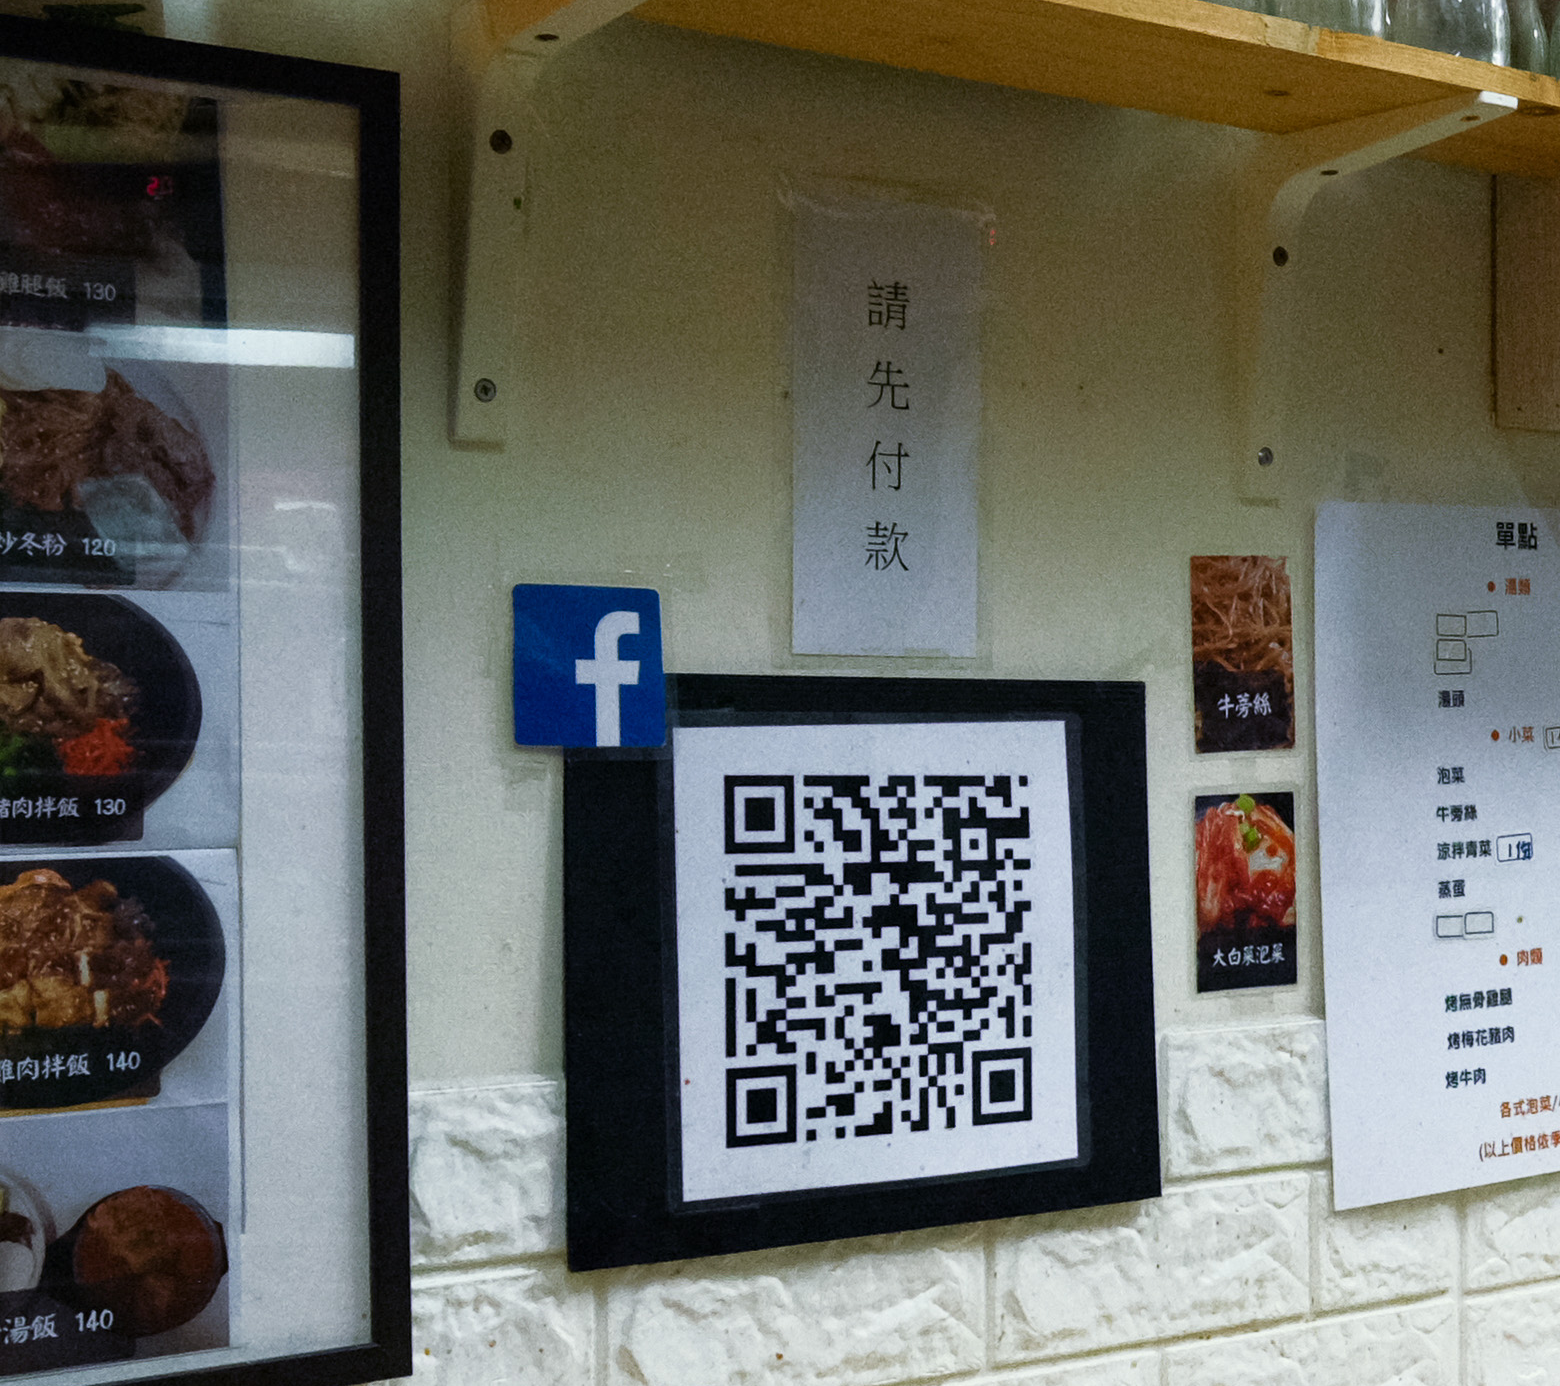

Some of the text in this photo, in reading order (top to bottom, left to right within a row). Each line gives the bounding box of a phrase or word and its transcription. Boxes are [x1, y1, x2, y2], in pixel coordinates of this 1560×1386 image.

[82, 281, 117, 303] 130
[865, 280, 912, 574] 請先付款
[82, 536, 117, 557] 120
[1496, 521, 1538, 551] 單點
[574, 610, 642, 747] f
[1508, 727, 1535, 744] 小菜
[1437, 767, 1465, 785] 泡菜
[95, 796, 127, 818] 130
[1437, 839, 1492, 860] 涼拌青菜
[105, 1050, 141, 1073] 140
[1445, 1068, 1486, 1090] 烤牛肉
[75, 1310, 114, 1332] 140
